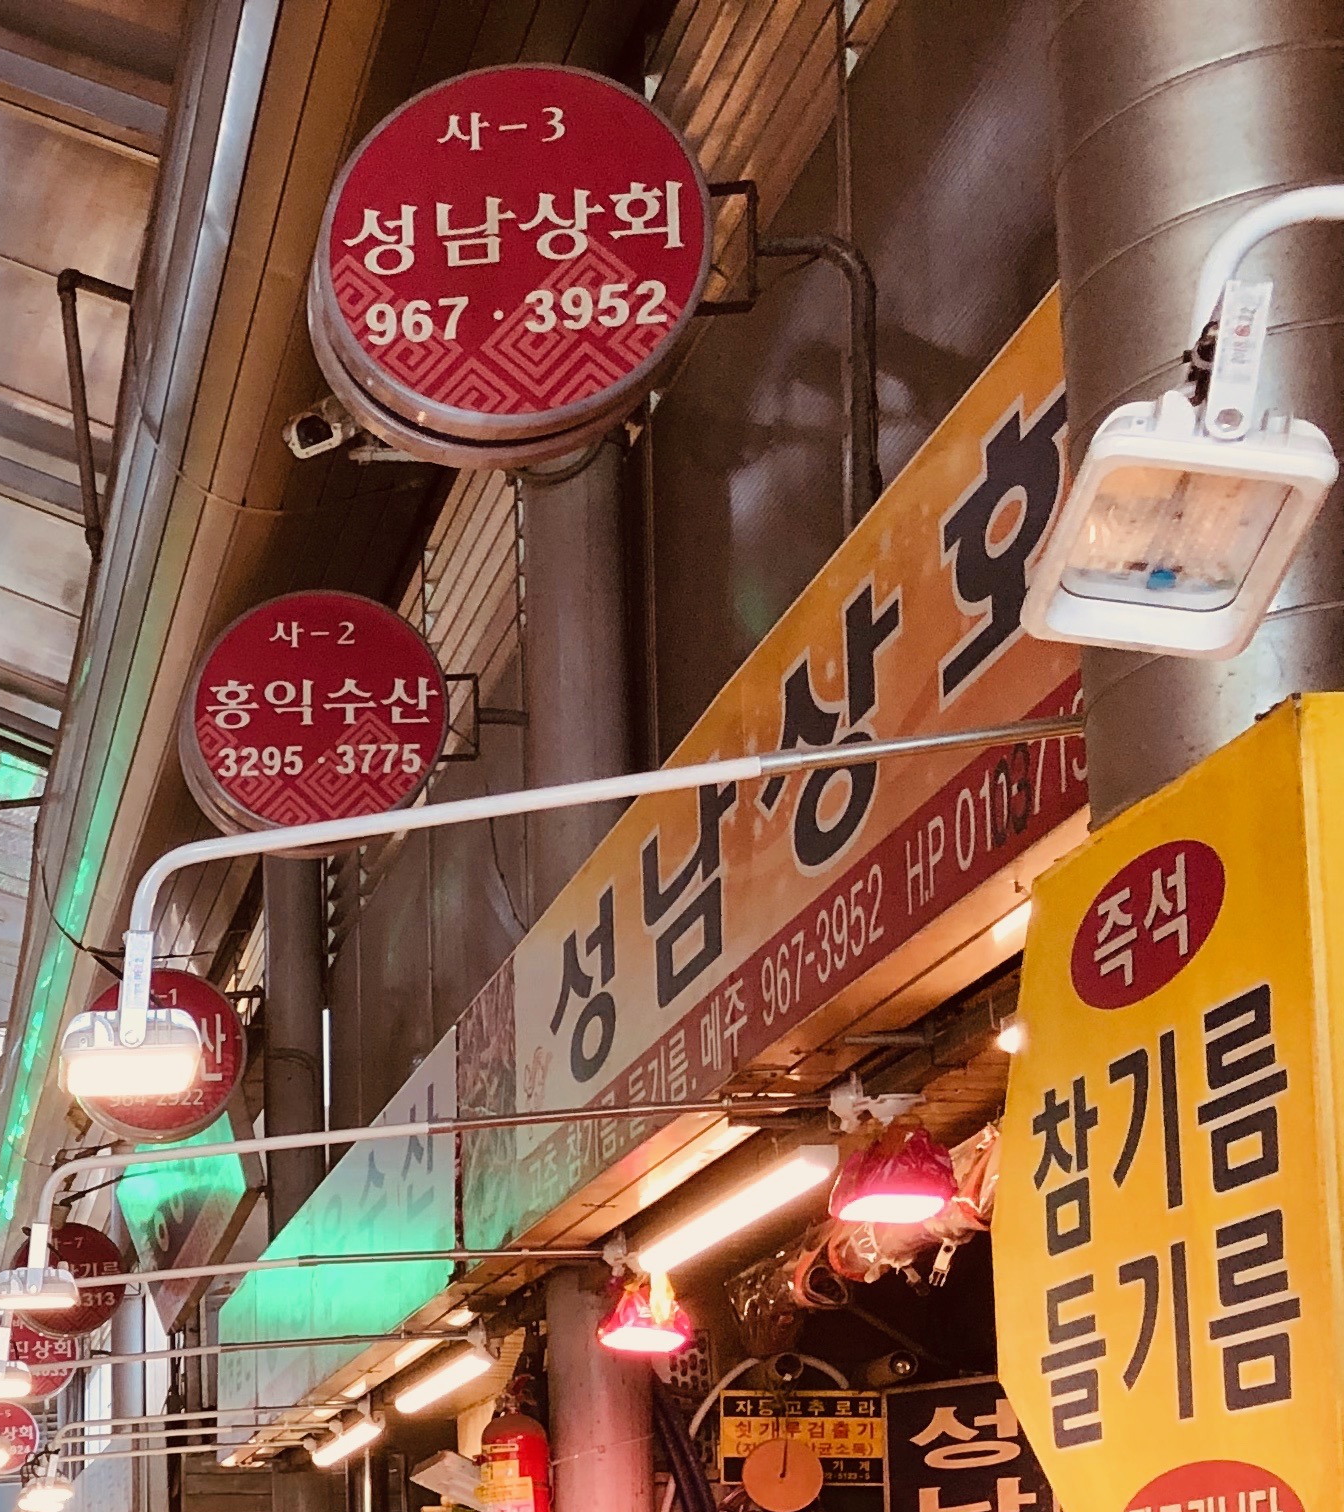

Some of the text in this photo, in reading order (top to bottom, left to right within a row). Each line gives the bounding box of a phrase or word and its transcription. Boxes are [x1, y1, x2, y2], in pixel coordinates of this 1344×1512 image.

[439, 107, 566, 151] 사-3
[344, 179, 687, 276] 성남상회
[269, 621, 356, 648] 사-2
[205, 676, 439, 730] 홍익수산
[1094, 852, 1190, 986] 즉석
[1032, 984, 1289, 1257] 참기름
[1041, 1209, 1302, 1449] 들기름
